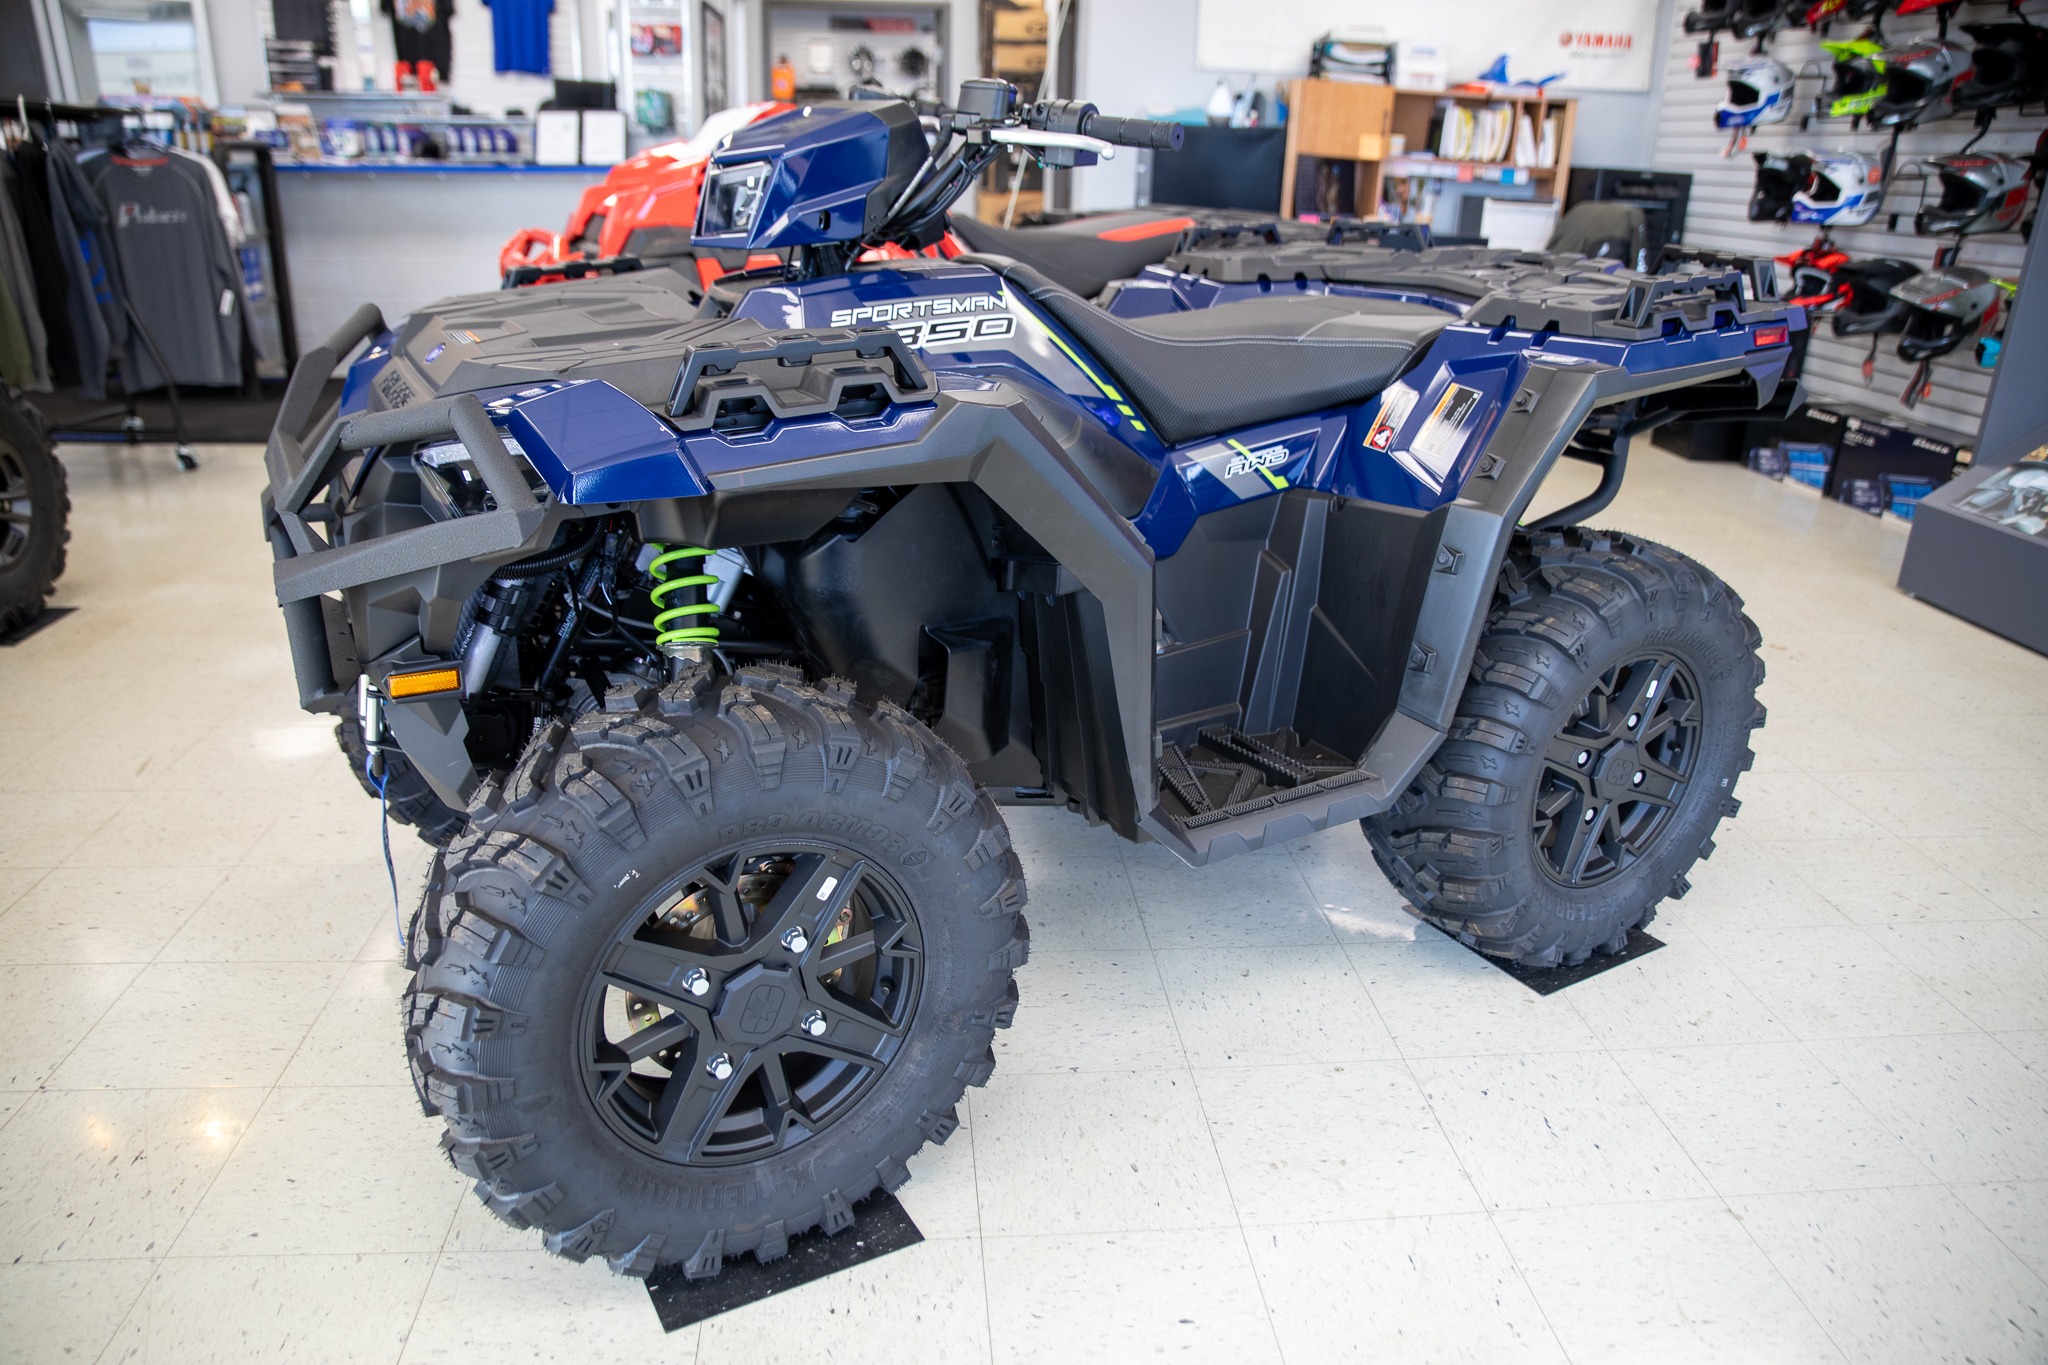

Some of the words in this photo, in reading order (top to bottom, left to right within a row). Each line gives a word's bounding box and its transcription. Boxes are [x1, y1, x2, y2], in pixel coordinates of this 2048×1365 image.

[830, 294, 1007, 328] SPORTSMAN
[1225, 448, 1289, 479] AWD
[719, 812, 788, 845] PRO
[796, 811, 907, 852] ARMOR
